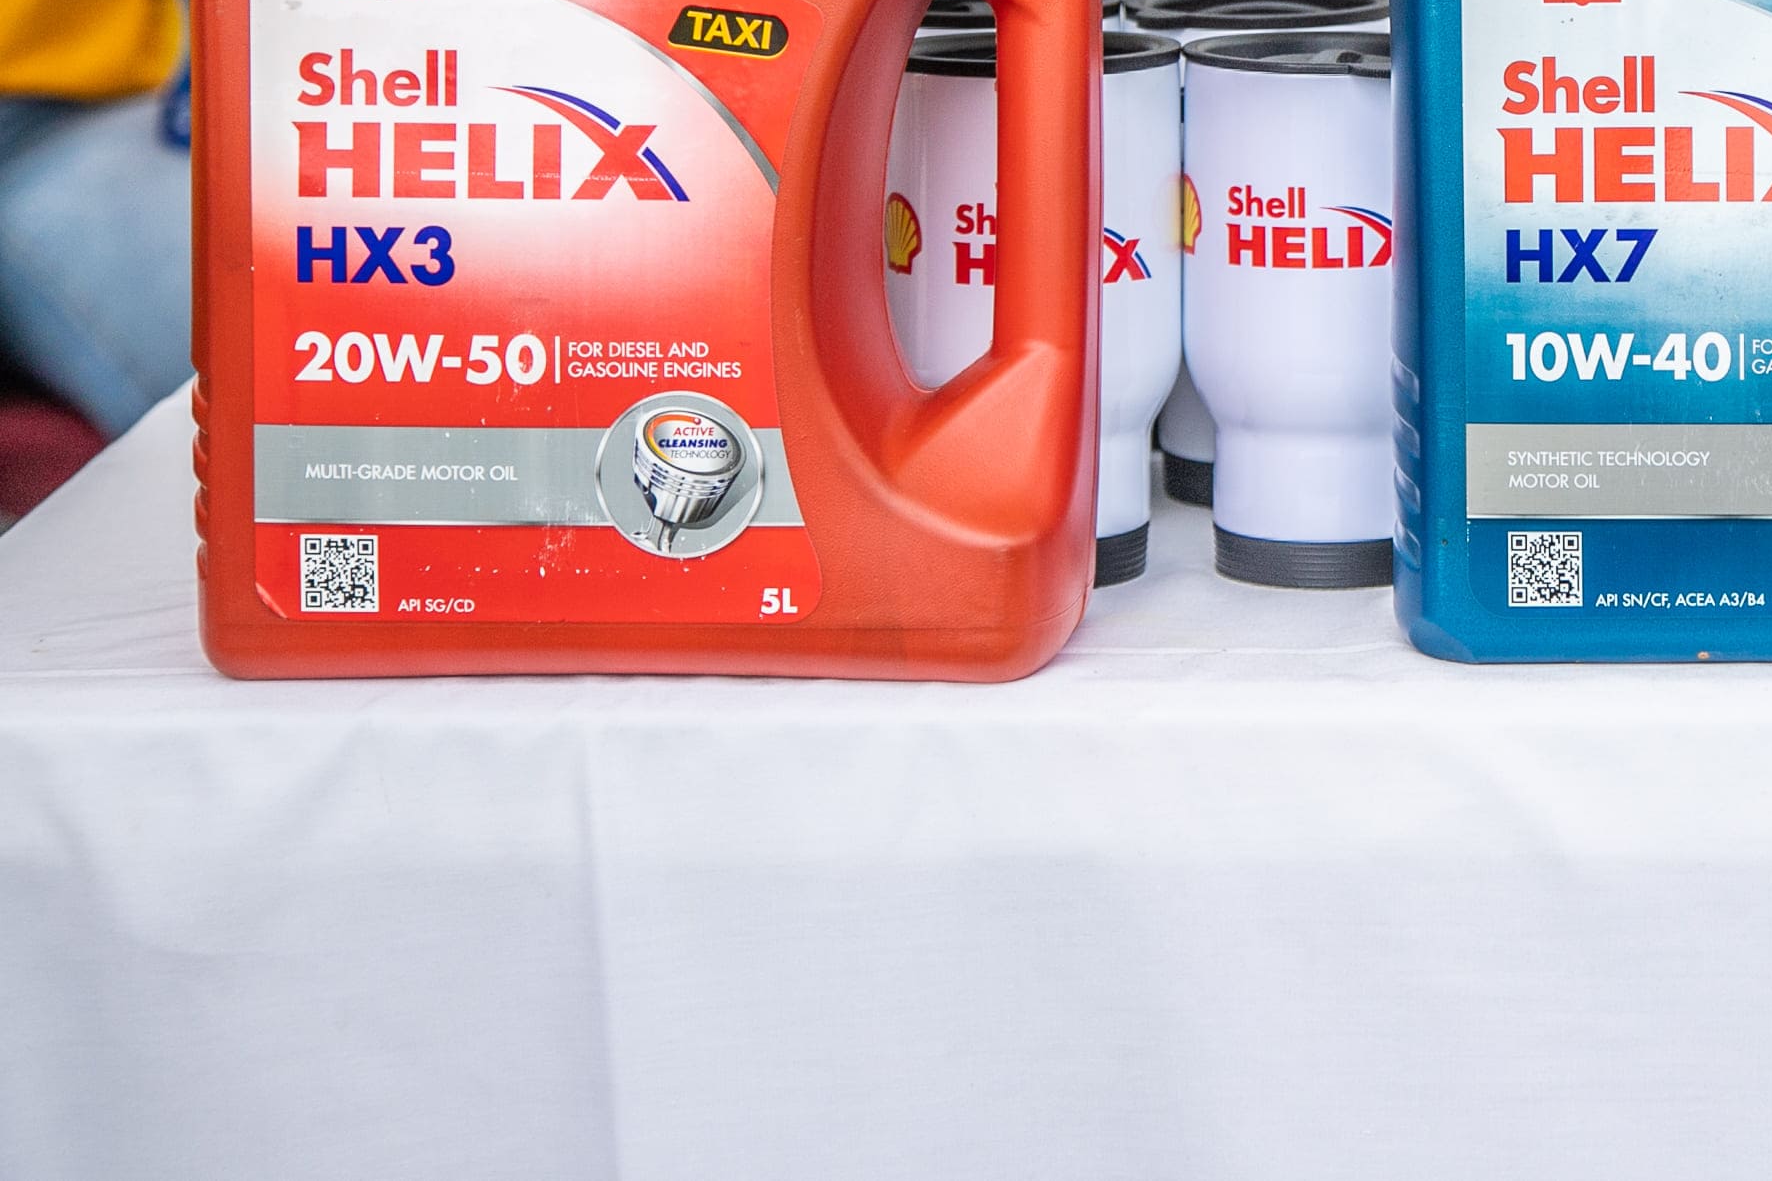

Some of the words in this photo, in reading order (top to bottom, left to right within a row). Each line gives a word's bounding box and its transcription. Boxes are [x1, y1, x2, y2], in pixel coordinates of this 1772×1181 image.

[686, 9, 772, 50] TAXI
[297, 48, 458, 107] Shell
[1502, 55, 1656, 115] Shell
[291, 85, 690, 202] HELIX
[1227, 184, 1306, 219] Shell
[296, 225, 456, 286] HX3
[1505, 229, 1659, 283] HX7
[294, 330, 548, 386] 20W-50
[568, 341, 603, 358] FOR
[608, 341, 663, 358] DIESEL
[668, 341, 709, 358] AND
[1506, 331, 1732, 382] 10W-40
[567, 361, 658, 378] GASOLINE
[663, 362, 742, 379] ENGINES
[673, 427, 714, 436] ACTIVE
[659, 439, 728, 448] CLEANSING
[670, 450, 731, 459] TECHNOLOGY
[1507, 451, 1593, 467] SYNTHETIC
[1597, 451, 1711, 467] TECHNOLOGY
[305, 463, 416, 480] MULTI-GRADE
[420, 465, 485, 481] MOTOR
[489, 465, 518, 481] OIL
[1508, 473, 1568, 489] MOTOR
[1572, 473, 1600, 489] OIL
[397, 598, 421, 612] API
[425, 597, 475, 613] SG/CD
[760, 588, 798, 615] 5L
[1595, 593, 1619, 607] API
[1622, 592, 1672, 610] SN/CF,
[1675, 593, 1716, 607] ACEA
[1719, 592, 1766, 608] A3/B4
